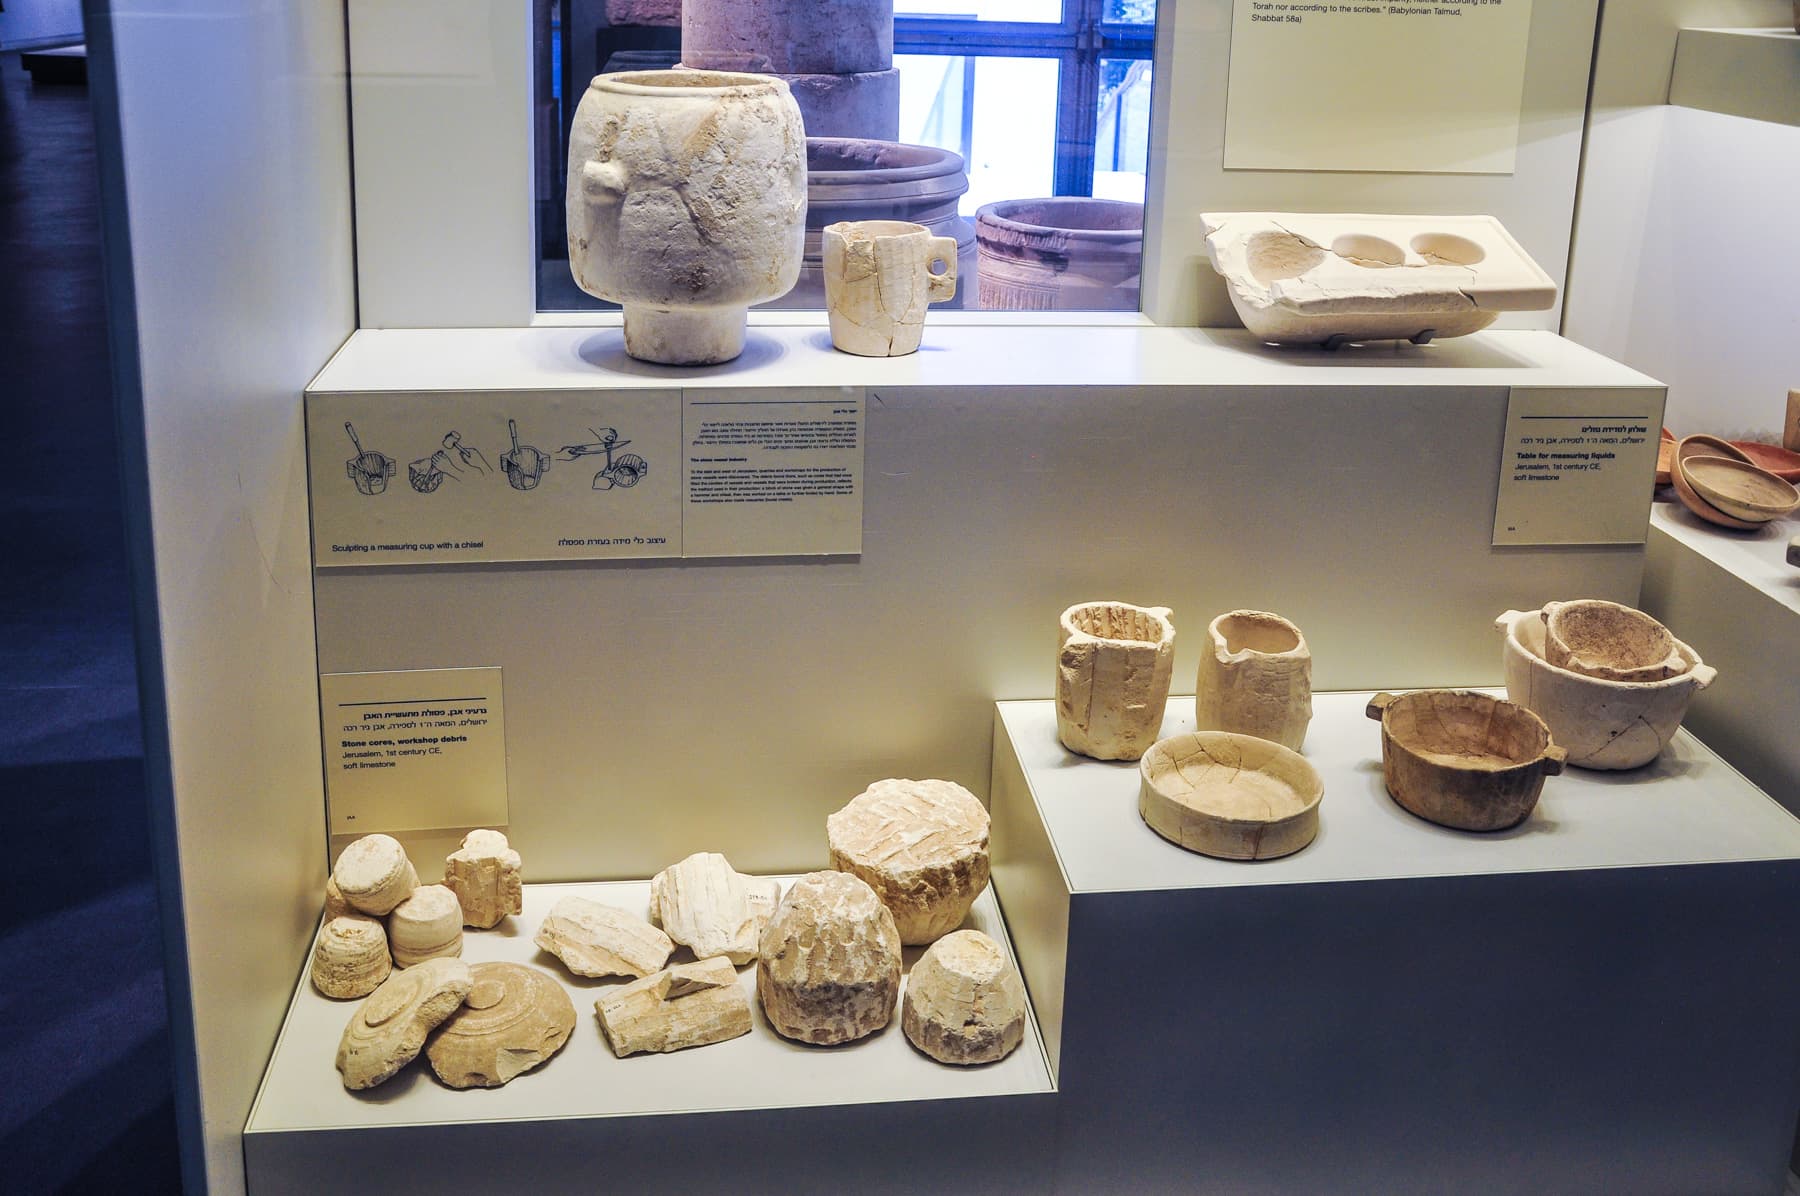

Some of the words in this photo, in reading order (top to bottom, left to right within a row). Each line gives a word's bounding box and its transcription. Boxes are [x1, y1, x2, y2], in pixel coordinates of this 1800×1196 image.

[1290, 4, 1328, 12] according
[1388, 6, 1432, 16] (Babylonian
[1252, 14, 1284, 22] Shabbat
[378, 543, 418, 551] measuring
[461, 540, 484, 548] chisel
